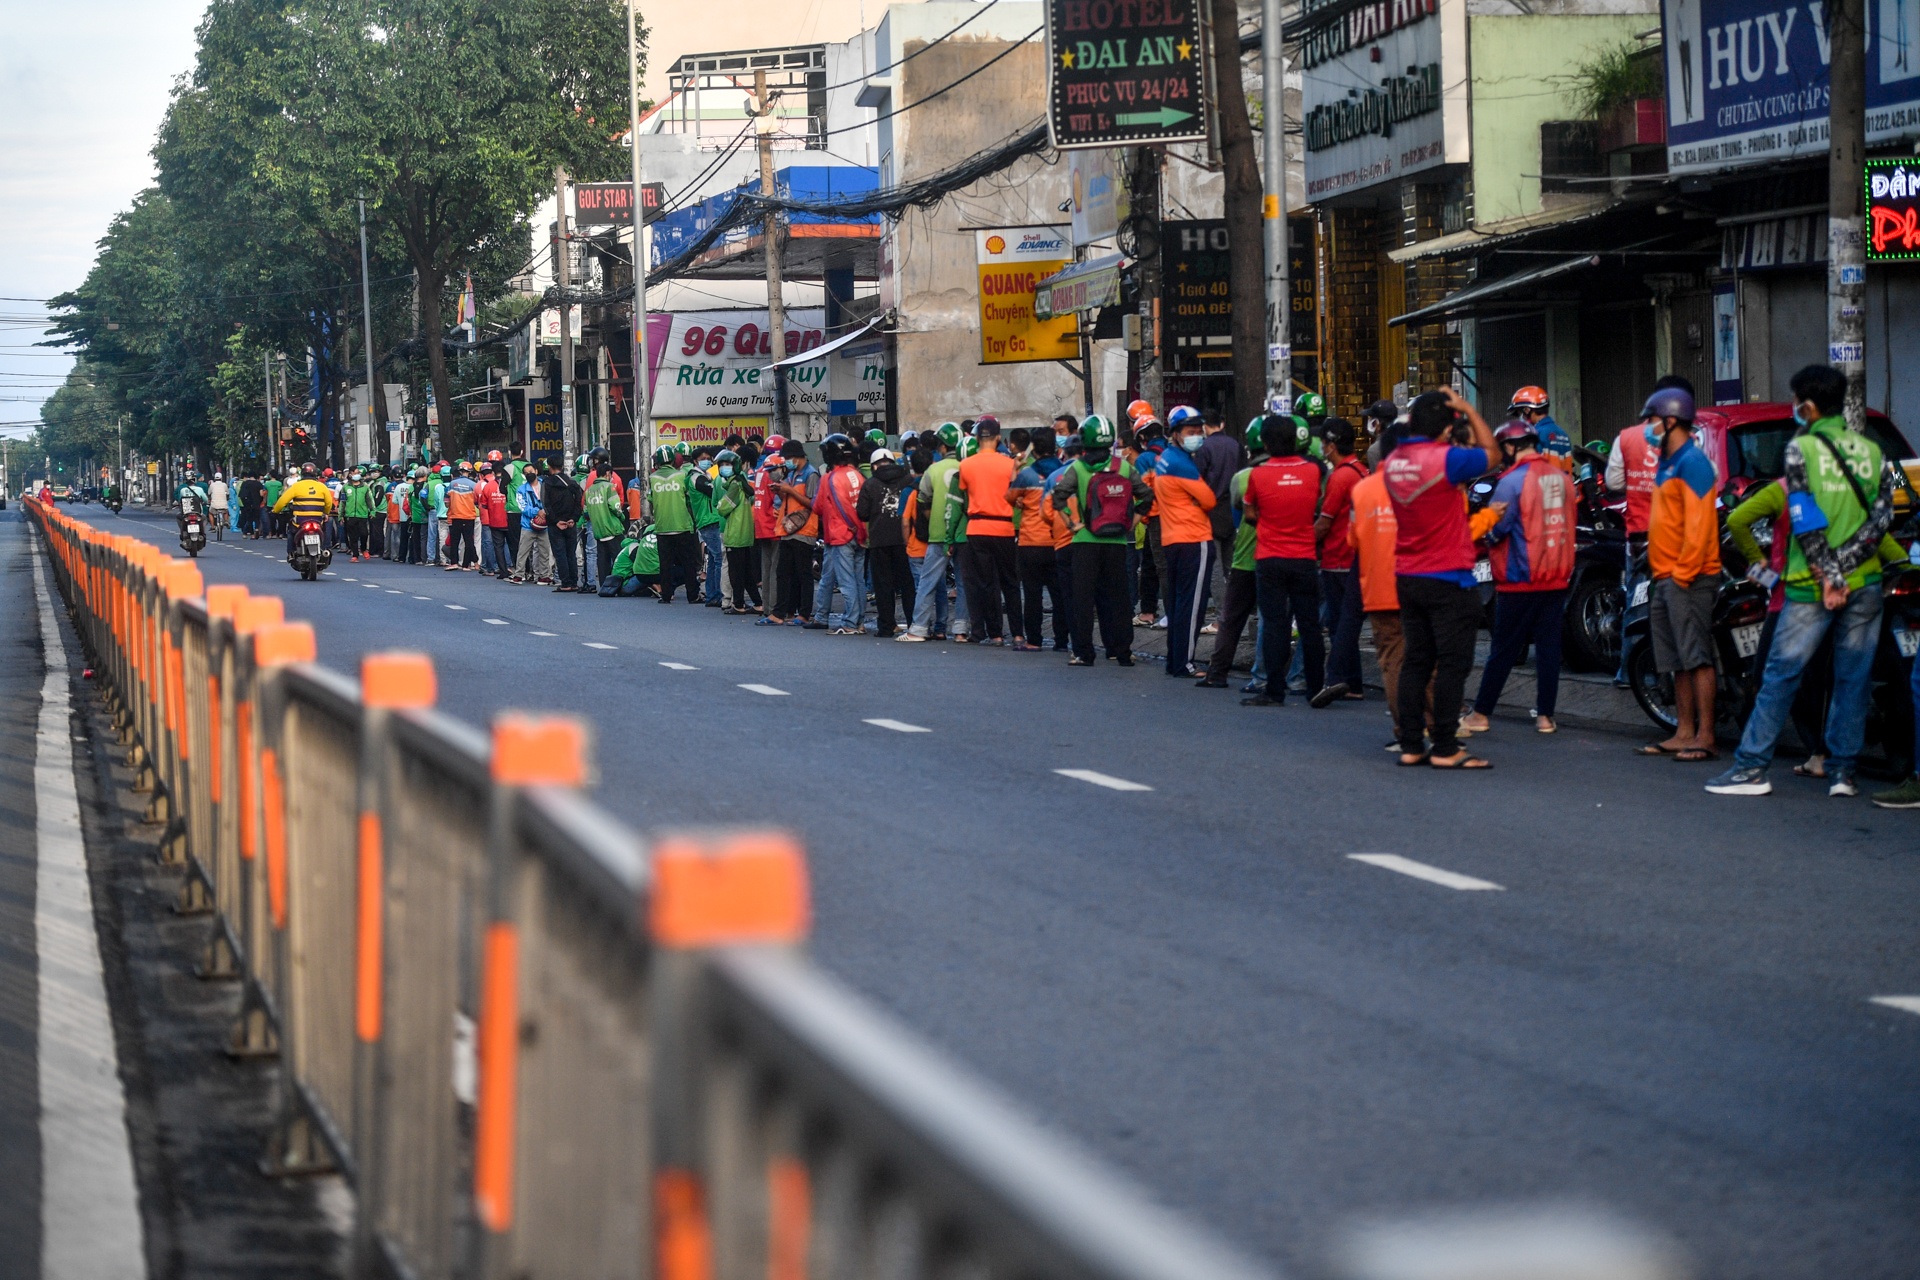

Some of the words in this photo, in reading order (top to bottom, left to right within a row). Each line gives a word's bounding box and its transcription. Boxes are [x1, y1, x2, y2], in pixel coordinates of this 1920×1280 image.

[1064, 0, 1185, 31] HOTEL
[1136, 36, 1174, 66] AN
[1708, 7, 1797, 90] HUY
[1067, 82, 1110, 108] PHỤC
[1114, 80, 1136, 106] VỤ
[1141, 77, 1189, 103] 24/24
[1717, 95, 1762, 127] CHUYÊN
[1764, 92, 1795, 120] CUNG
[1069, 114, 1092, 132] WIFI
[1720, 139, 1743, 156] TRUNG
[579, 189, 601, 209] GOLF
[604, 188, 627, 208] STAR
[630, 187, 658, 208] HTEL
[1016, 239, 1063, 250] ADVANCE
[1181, 226, 1303, 251] HOL
[983, 272, 1036, 297] QUANG
[1210, 281, 1228, 296] 40
[1296, 279, 1312, 293] 10
[985, 302, 1029, 324] Chuyên:
[1178, 303, 1206, 316] QUA
[1292, 297, 1313, 312] 50
[681, 325, 728, 356] 96
[733, 322, 827, 356] Quan
[986, 336, 1006, 357] Tay
[1009, 335, 1026, 352] Ga
[676, 362, 724, 386] Rửa
[731, 367, 760, 385] xe
[706, 397, 718, 406] 96
[719, 395, 749, 407] Quang
[800, 393, 812, 404] Gò
[535, 419, 559, 436] ĐẬU
[680, 424, 719, 442] TRƯỜNG
[1818, 454, 1873, 479] Food
[653, 480, 680, 493] Grab
